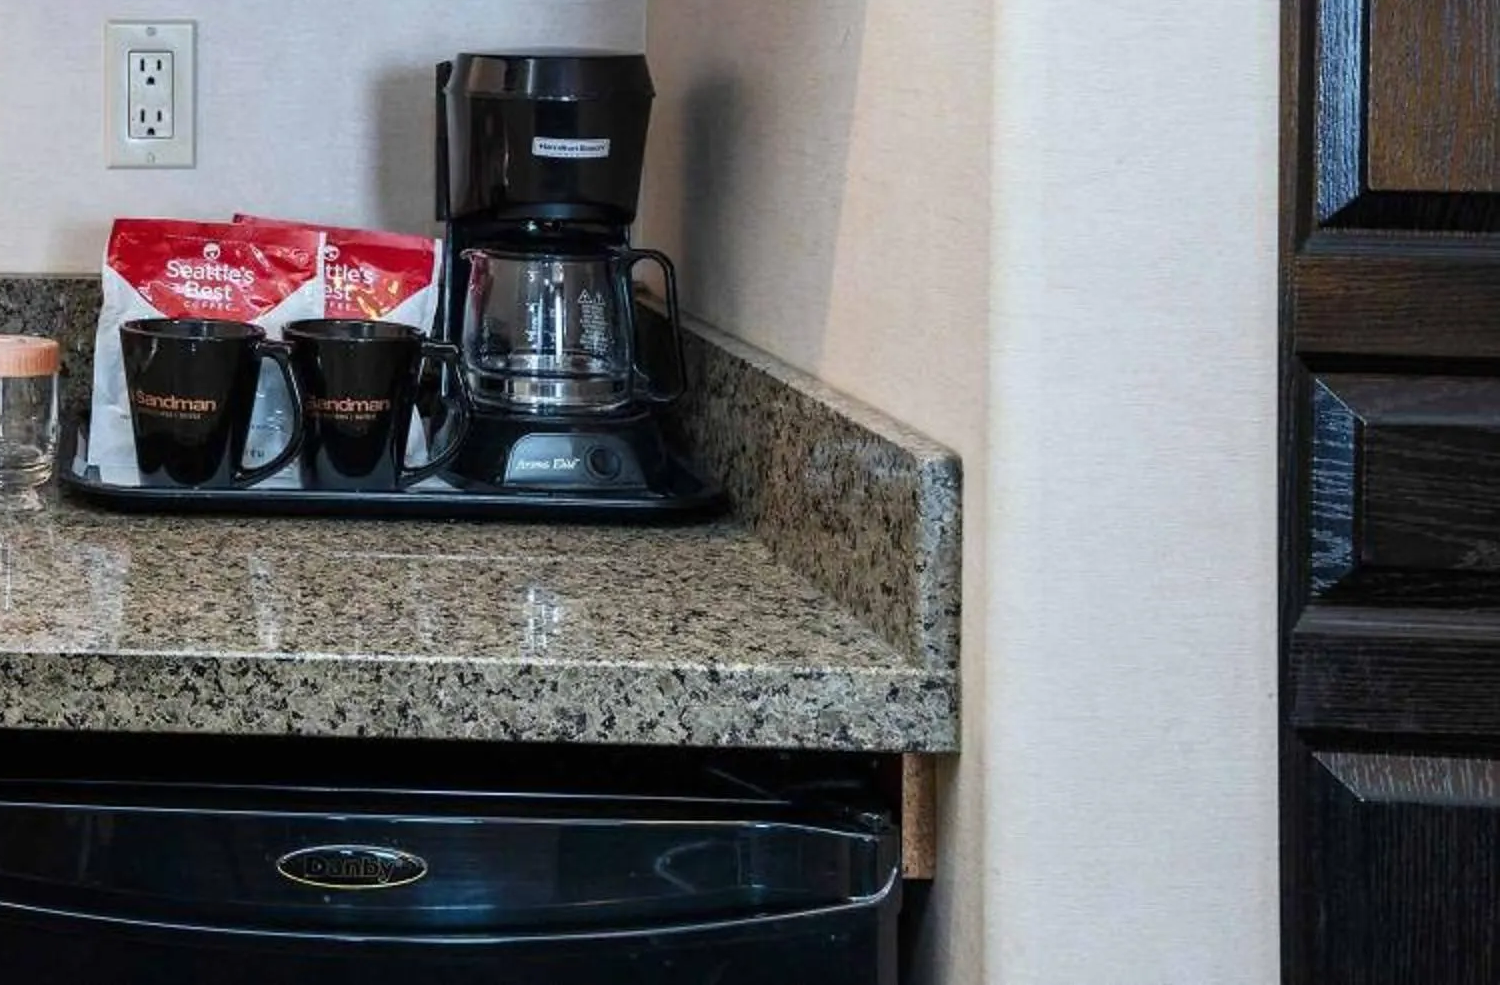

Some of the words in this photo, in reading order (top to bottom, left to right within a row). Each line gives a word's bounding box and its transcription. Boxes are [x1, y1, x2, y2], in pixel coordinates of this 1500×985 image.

[166, 260, 255, 285] Seattle's
[325, 263, 373, 284] ttle's
[183, 280, 233, 302] Best
[325, 284, 353, 302] est
[136, 390, 217, 413] Sandman
[303, 854, 395, 884] Danby
